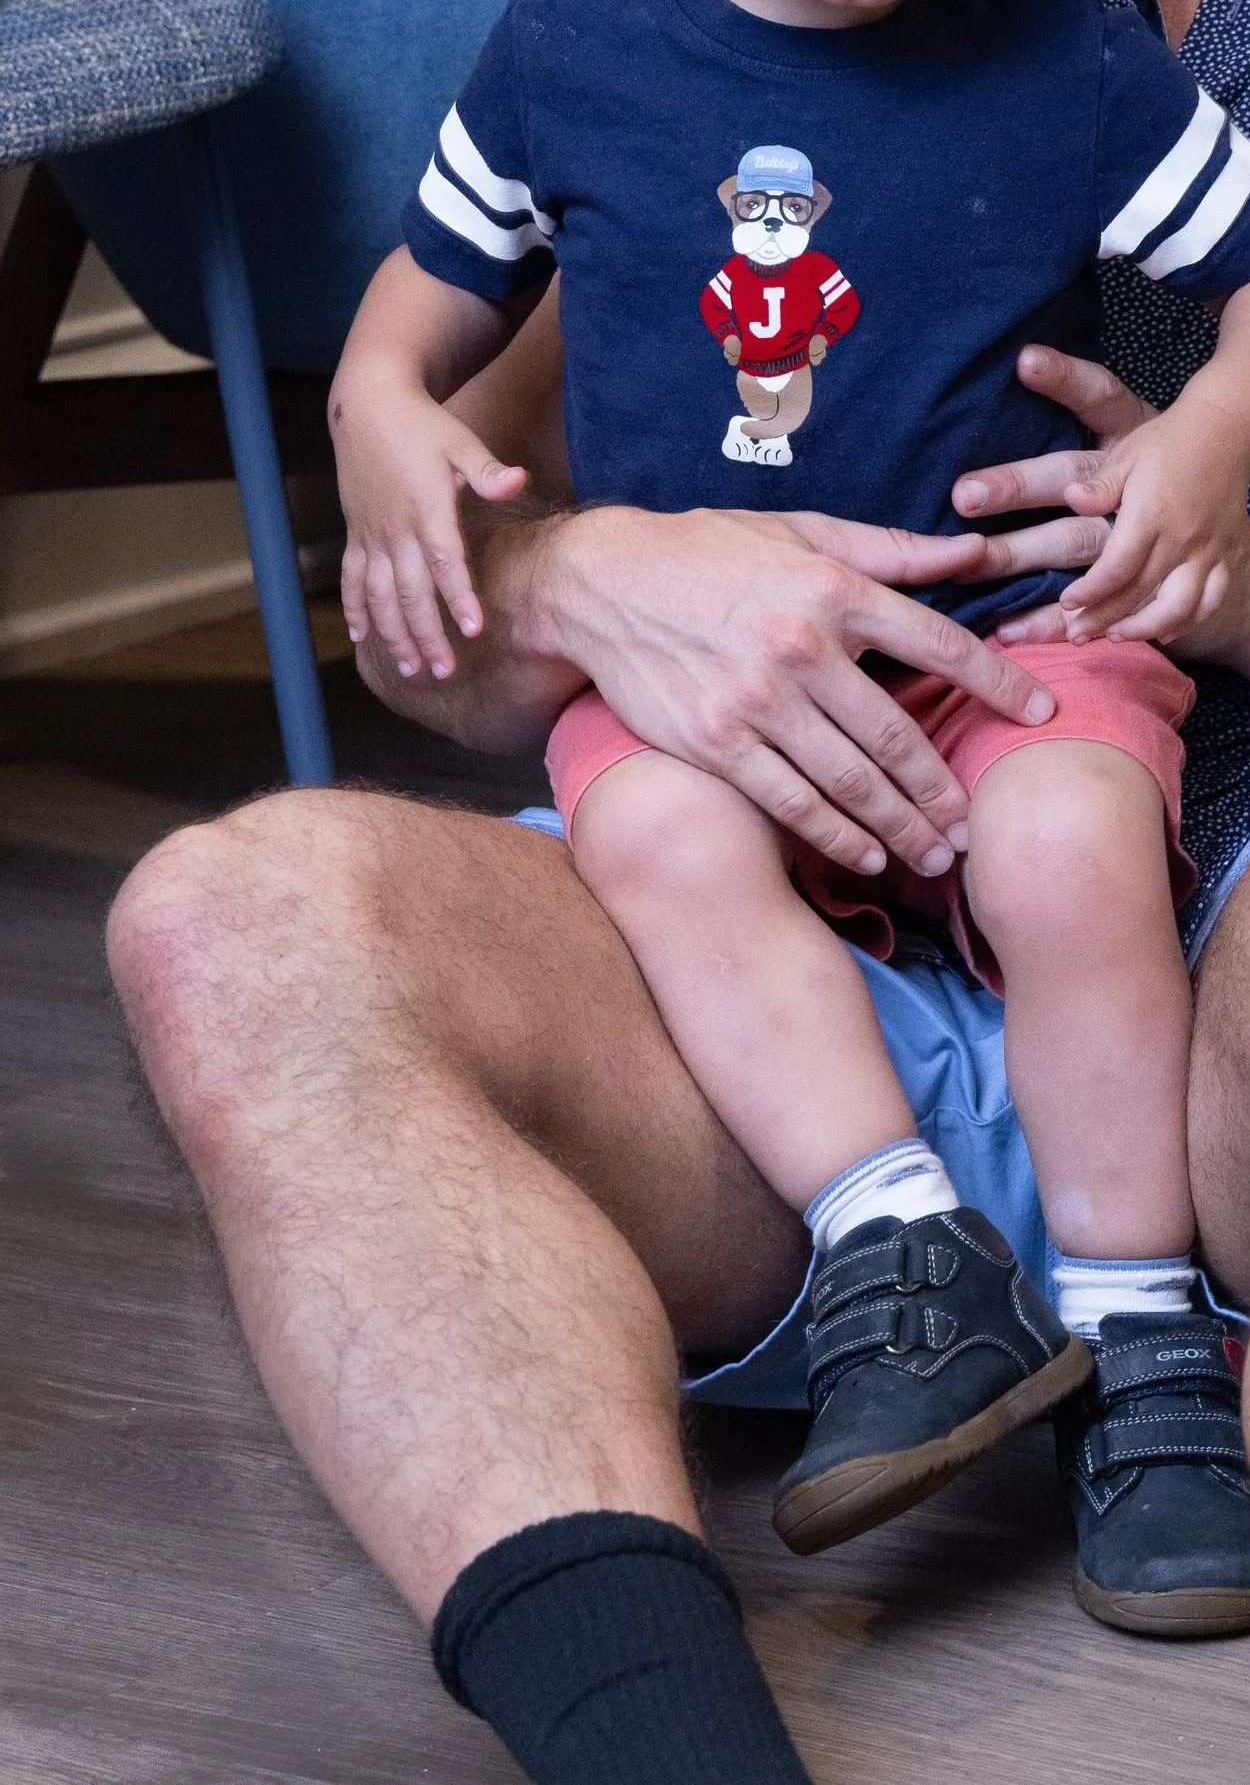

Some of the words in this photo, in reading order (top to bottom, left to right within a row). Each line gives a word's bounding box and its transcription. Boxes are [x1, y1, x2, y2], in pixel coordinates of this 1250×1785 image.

[754, 155, 799, 173] Bulldogs
[749, 287, 785, 338] J
[1156, 1348, 1211, 1361] GEOX
